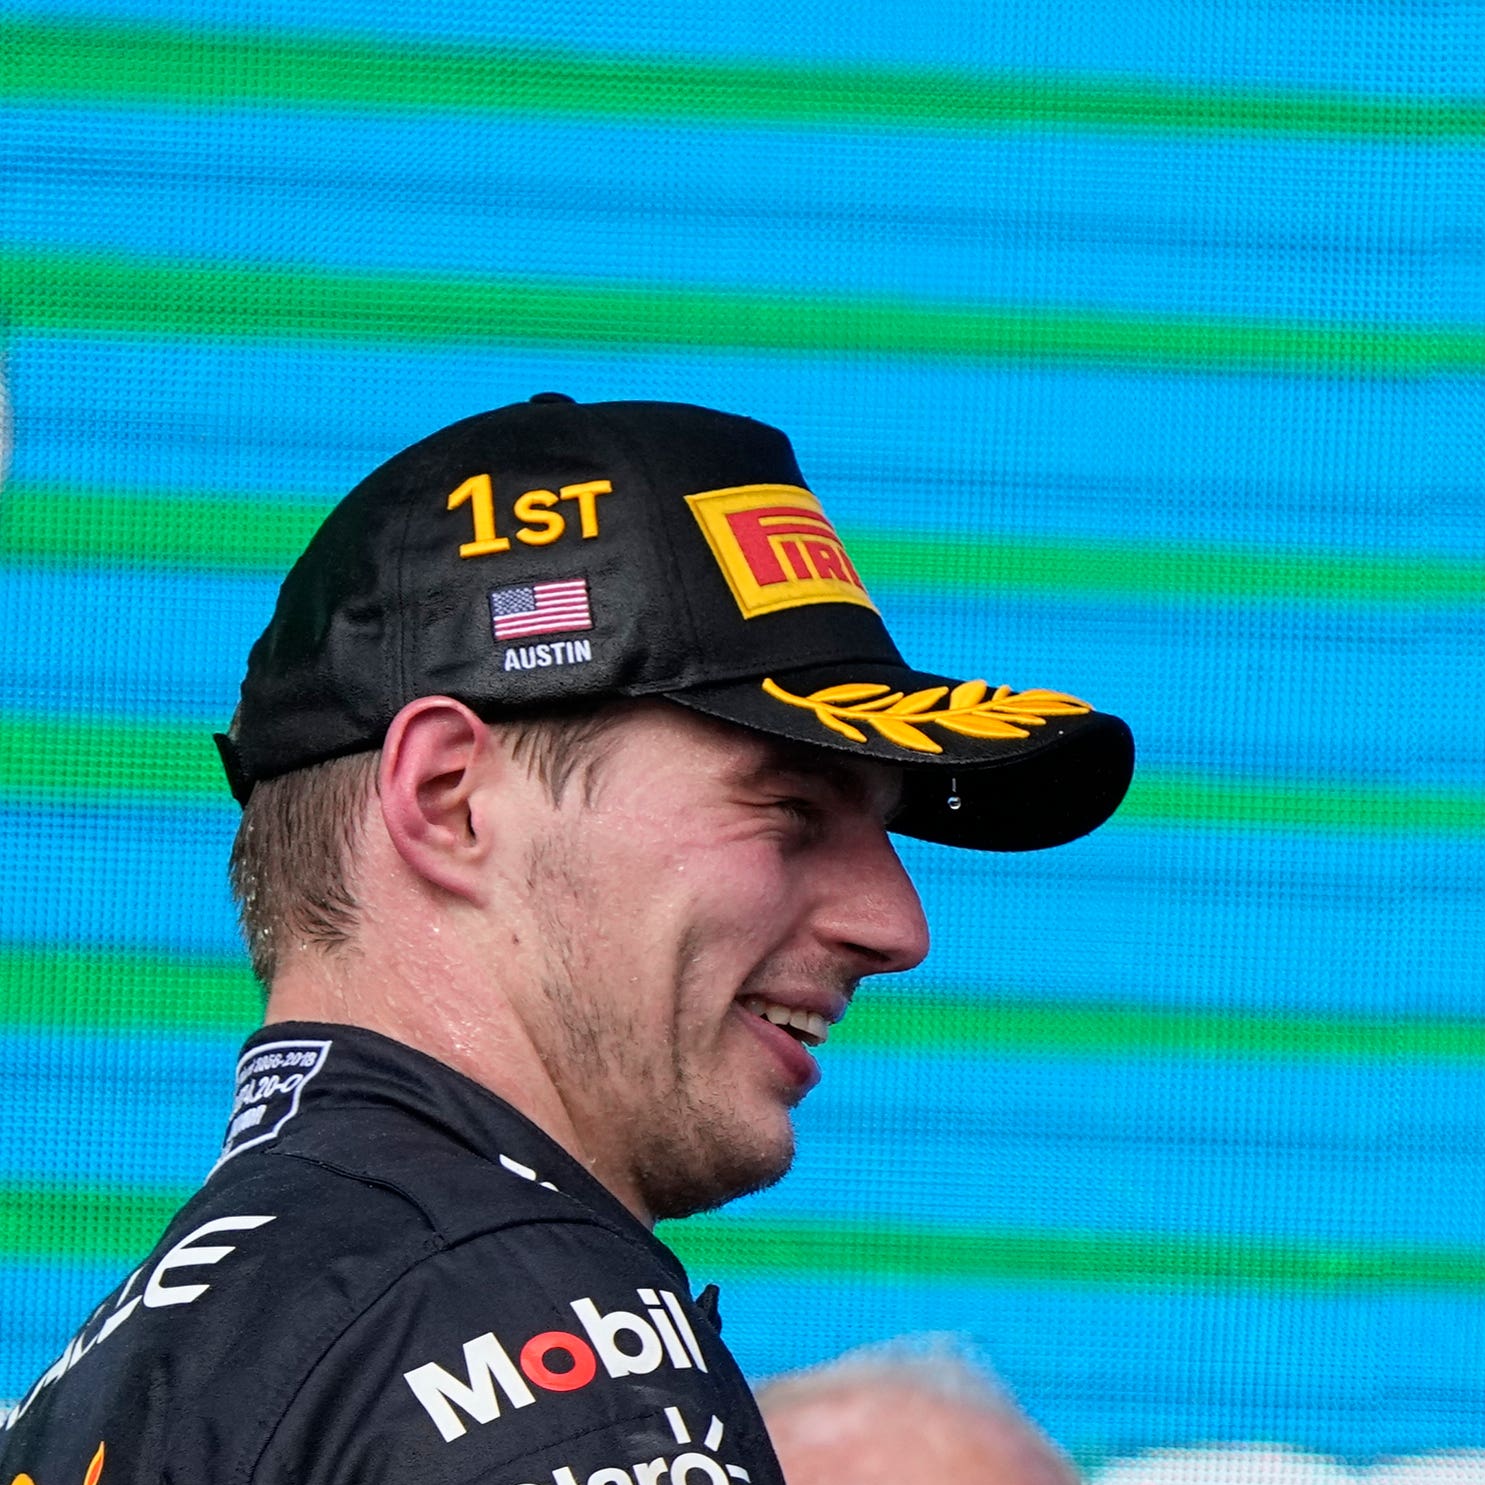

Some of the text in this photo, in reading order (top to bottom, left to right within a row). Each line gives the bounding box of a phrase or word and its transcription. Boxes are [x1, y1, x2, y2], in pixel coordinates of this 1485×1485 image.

[447, 473, 613, 558] 1ST
[504, 639, 592, 671] AUSTIN
[403, 1288, 708, 1443] Mobil
